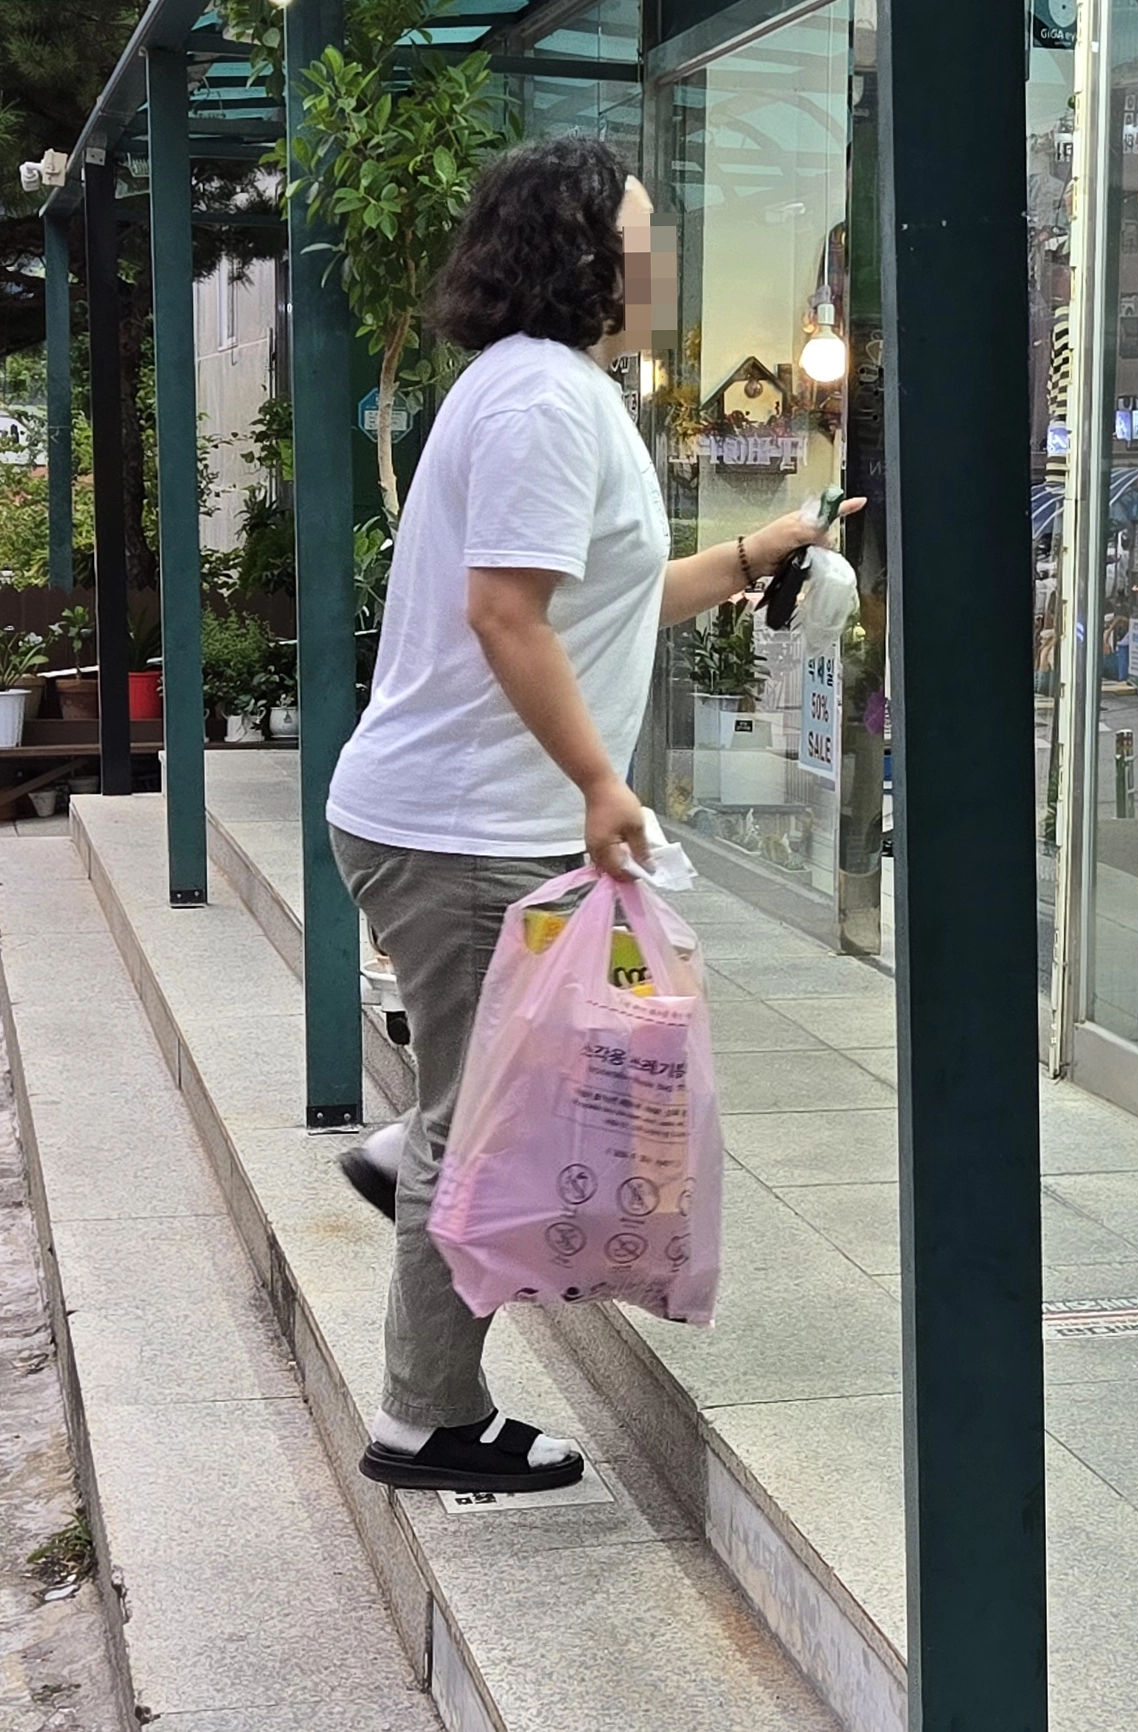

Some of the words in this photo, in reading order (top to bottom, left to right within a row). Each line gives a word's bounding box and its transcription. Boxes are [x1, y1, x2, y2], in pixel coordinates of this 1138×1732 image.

[811, 692, 829, 722] 50%
[808, 731, 831, 764] SALE
[580, 1044, 627, 1066] 소각용
